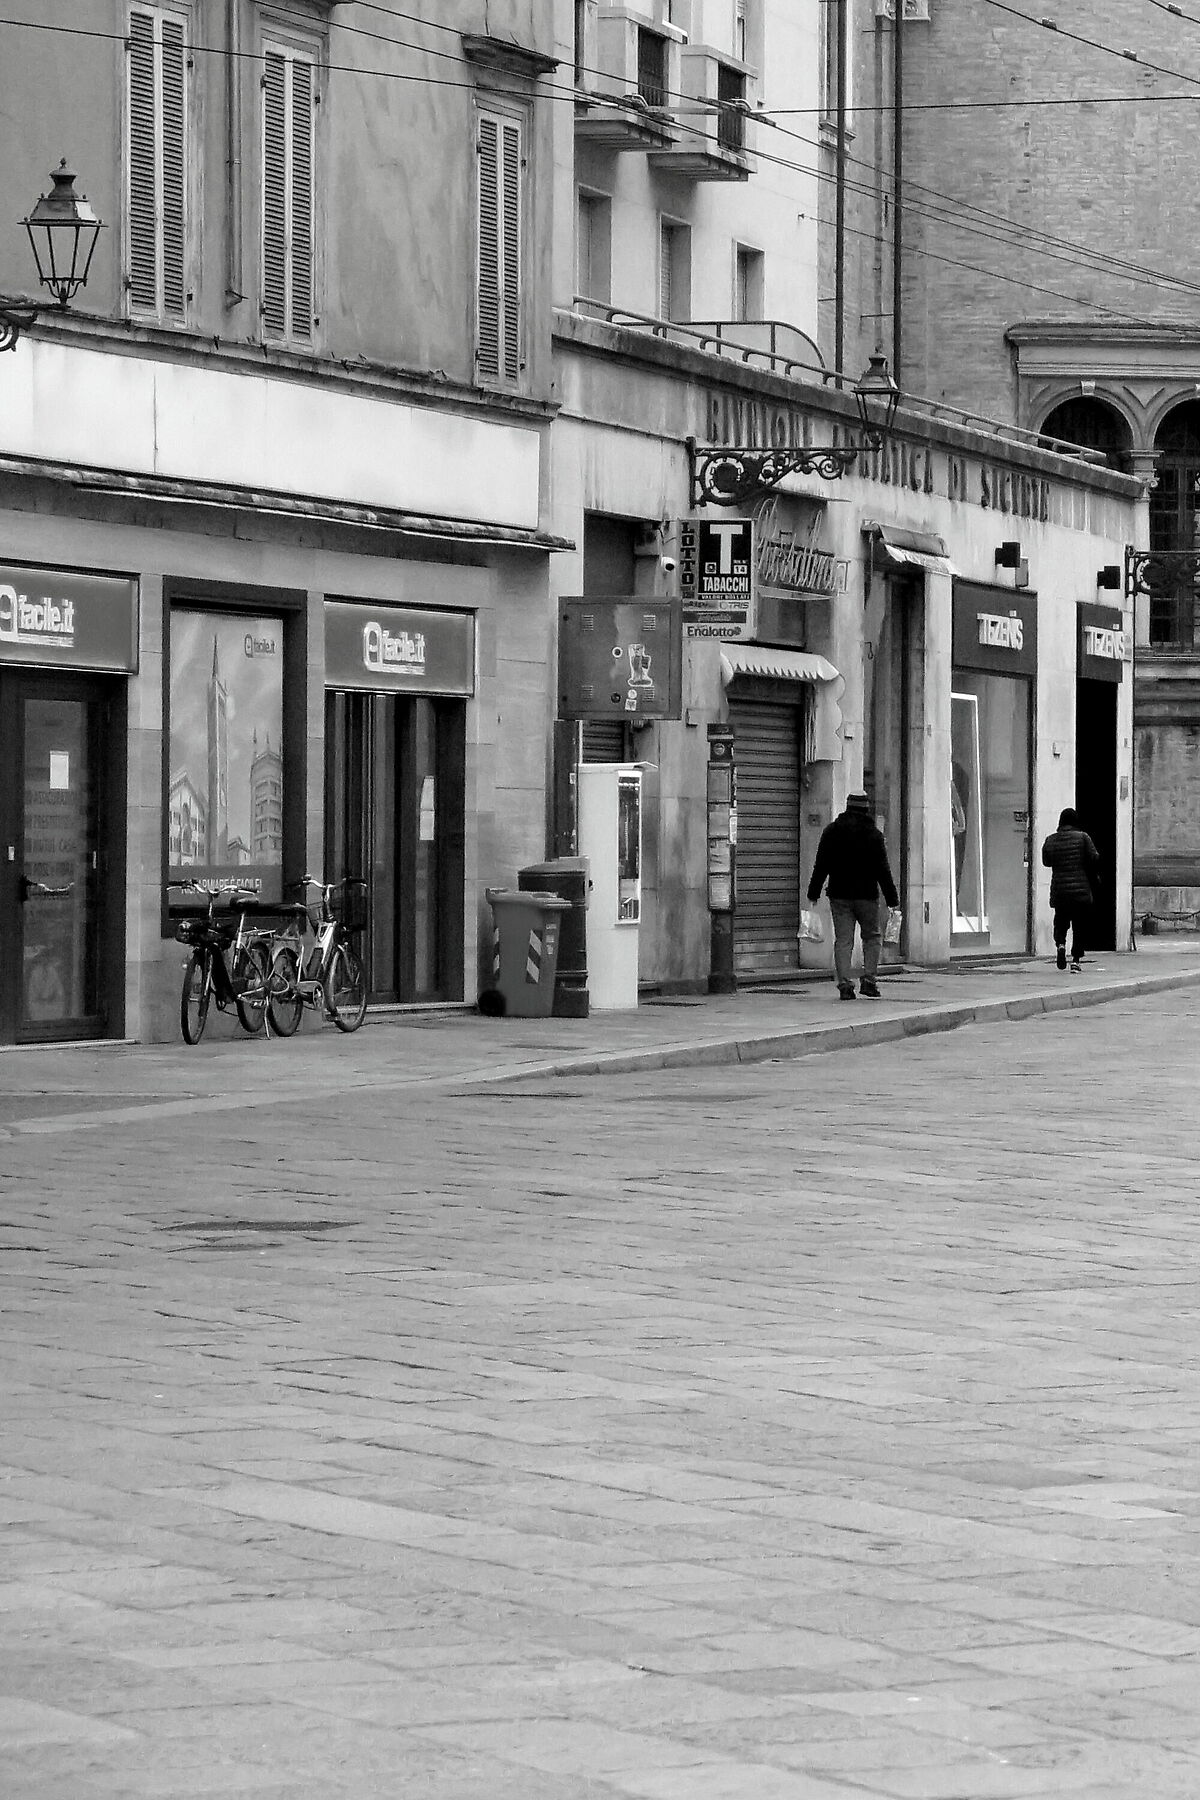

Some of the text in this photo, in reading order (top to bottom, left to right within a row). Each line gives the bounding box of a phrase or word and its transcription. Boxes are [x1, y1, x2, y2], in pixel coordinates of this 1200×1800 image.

[680, 522, 696, 585] LOTTO
[709, 524, 744, 575] T
[702, 576, 750, 592] TABACCHI
[18, 594, 75, 634] facile.it
[687, 625, 735, 637] Enalotto
[976, 609, 1024, 651] TEZENIS
